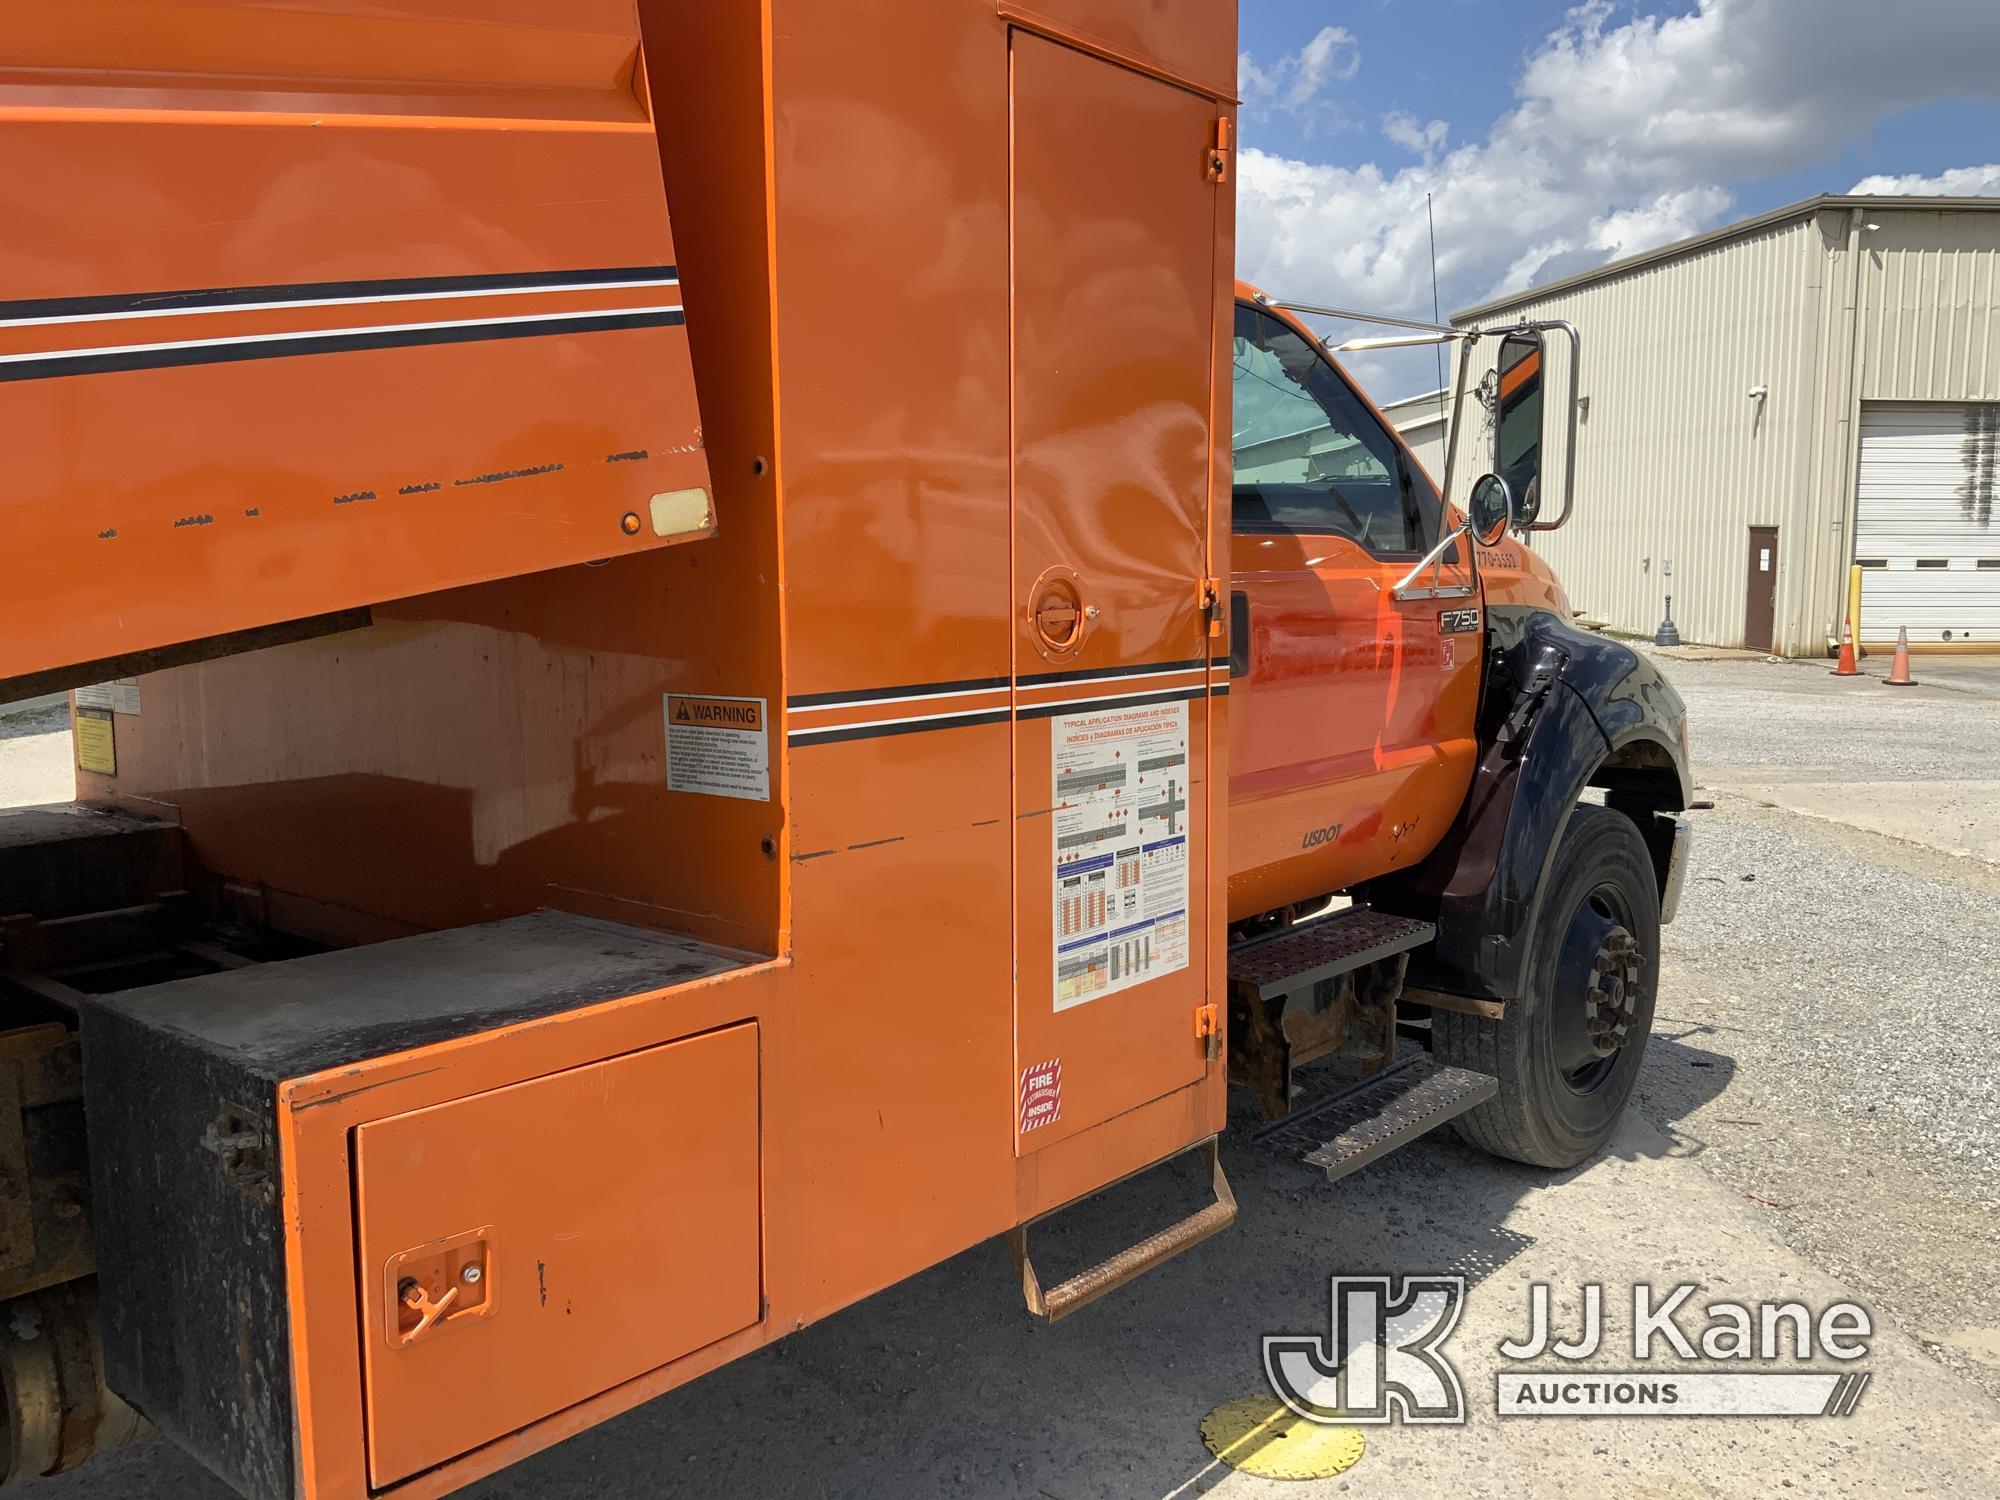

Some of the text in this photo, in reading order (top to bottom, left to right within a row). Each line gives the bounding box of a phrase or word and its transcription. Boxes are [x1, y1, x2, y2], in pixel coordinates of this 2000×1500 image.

[1454, 624, 1468, 632] SUPER
[692, 704, 756, 723] WARNING
[1064, 719, 1087, 729] TYPICAL
[1088, 714, 1122, 726] APPLICATION
[1123, 711, 1149, 721] DIAGRAMS
[1149, 709, 1160, 718] AND
[1094, 728, 1125, 740] DIAGRAMAS
[1125, 727, 1133, 735] DE
[1302, 823, 1343, 849] USDOT
[1029, 1072, 1053, 1091] FIRE
[1028, 1101, 1053, 1117] INSIDE
